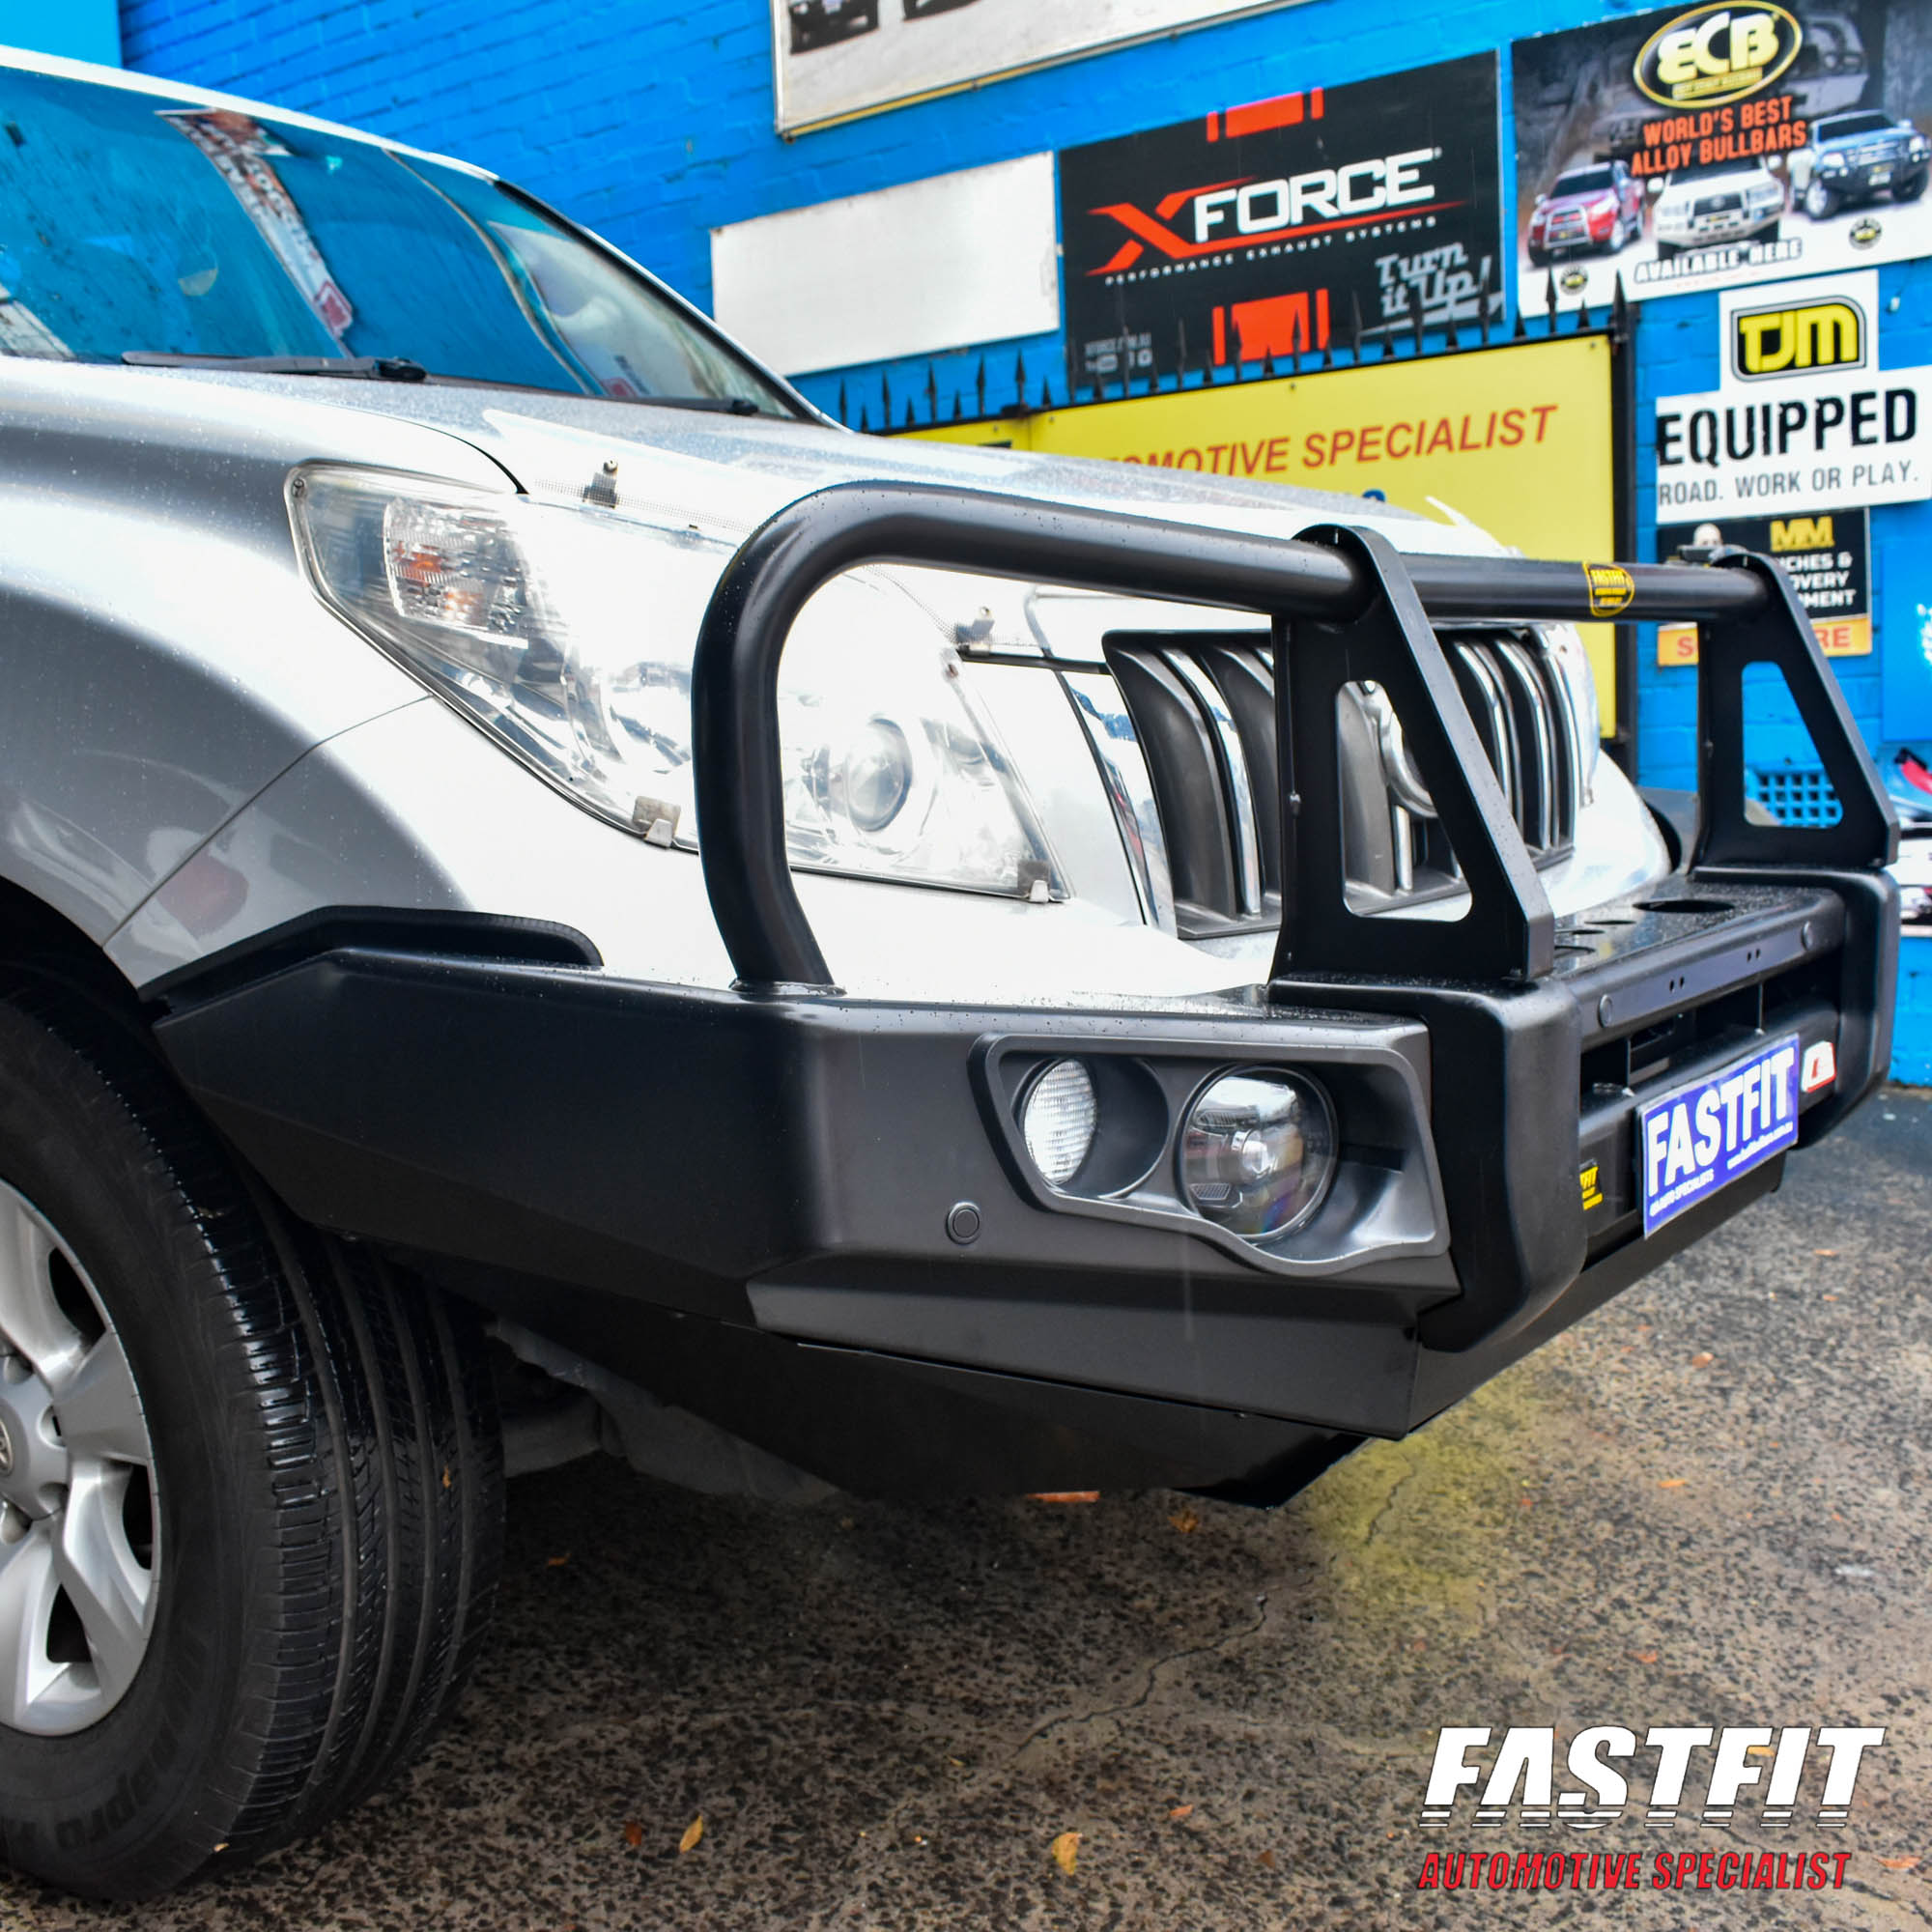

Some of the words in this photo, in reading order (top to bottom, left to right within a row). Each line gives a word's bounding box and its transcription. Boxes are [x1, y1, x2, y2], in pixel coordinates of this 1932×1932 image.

[1657, 12, 1779, 84] ECB
[1631, 142, 1692, 177] ALLOY
[1698, 121, 1808, 165] BULLBARS
[1644, 107, 1735, 147] WORLD'S
[1740, 97, 1793, 129] BEST
[1086, 147, 1435, 276] XFORCE
[1105, 253, 1234, 286] PERFORMANCE
[1246, 235, 1332, 261] EXHAUST
[1345, 215, 1436, 242] SYSTEMS
[1375, 242, 1469, 288] Turn
[1380, 283, 1410, 318] it
[1408, 255, 1492, 317] Up!
[1302, 404, 1559, 469] SPECIALIST
[1656, 387, 1917, 469] EQUIPPED
[1659, 479, 1723, 506] ROAD.
[1735, 470, 1801, 499] WORK
[1812, 467, 1841, 492] OR
[1852, 459, 1918, 488] PLAY.
[1647, 1046, 1795, 1197] FASTFIT
